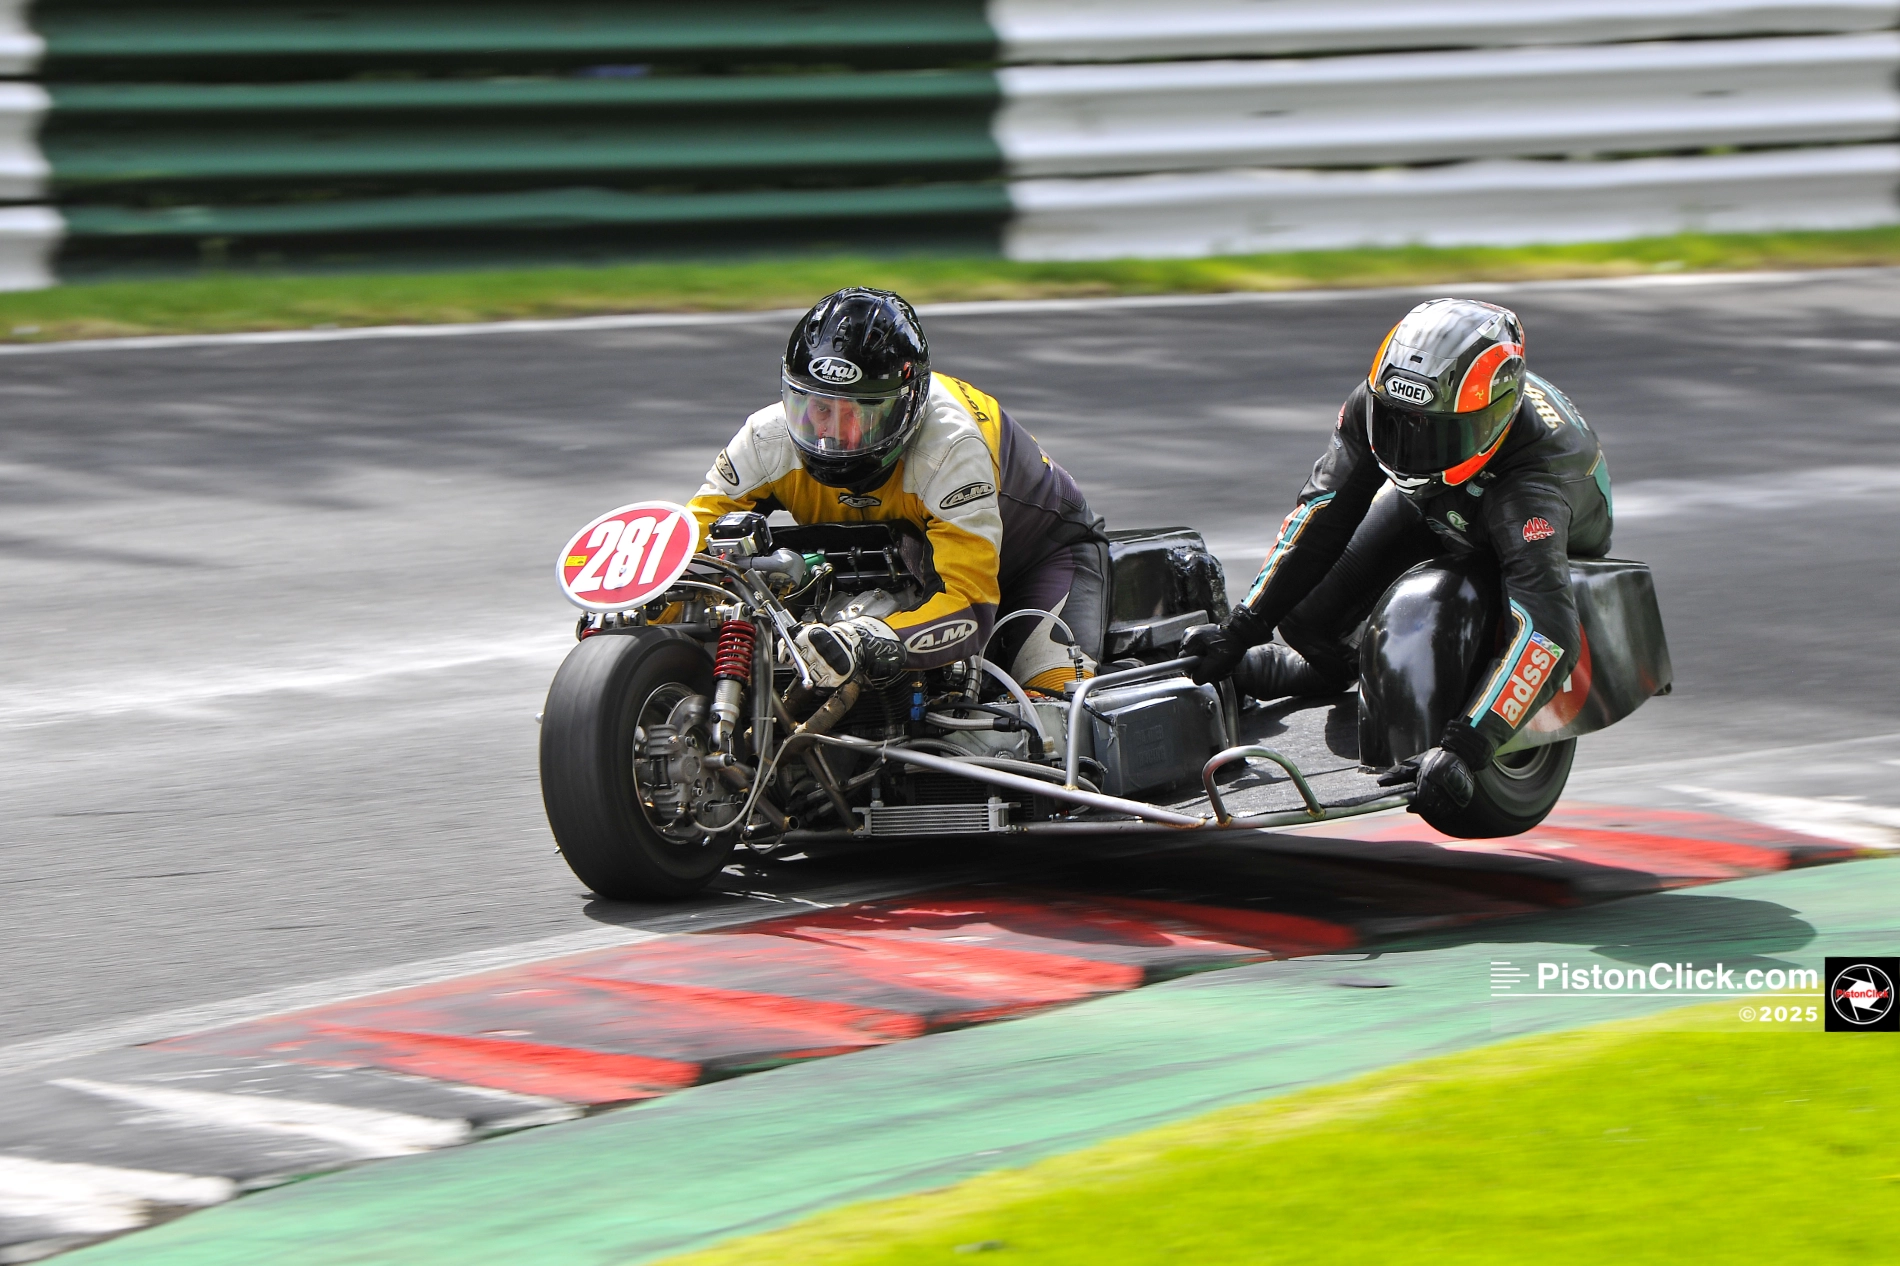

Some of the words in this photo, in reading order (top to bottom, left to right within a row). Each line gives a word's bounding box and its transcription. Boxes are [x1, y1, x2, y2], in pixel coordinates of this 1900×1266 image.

[812, 358, 856, 379] Arai
[1391, 380, 1426, 401] SHOEI
[568, 511, 682, 594] 281
[1502, 649, 1550, 722] adss
